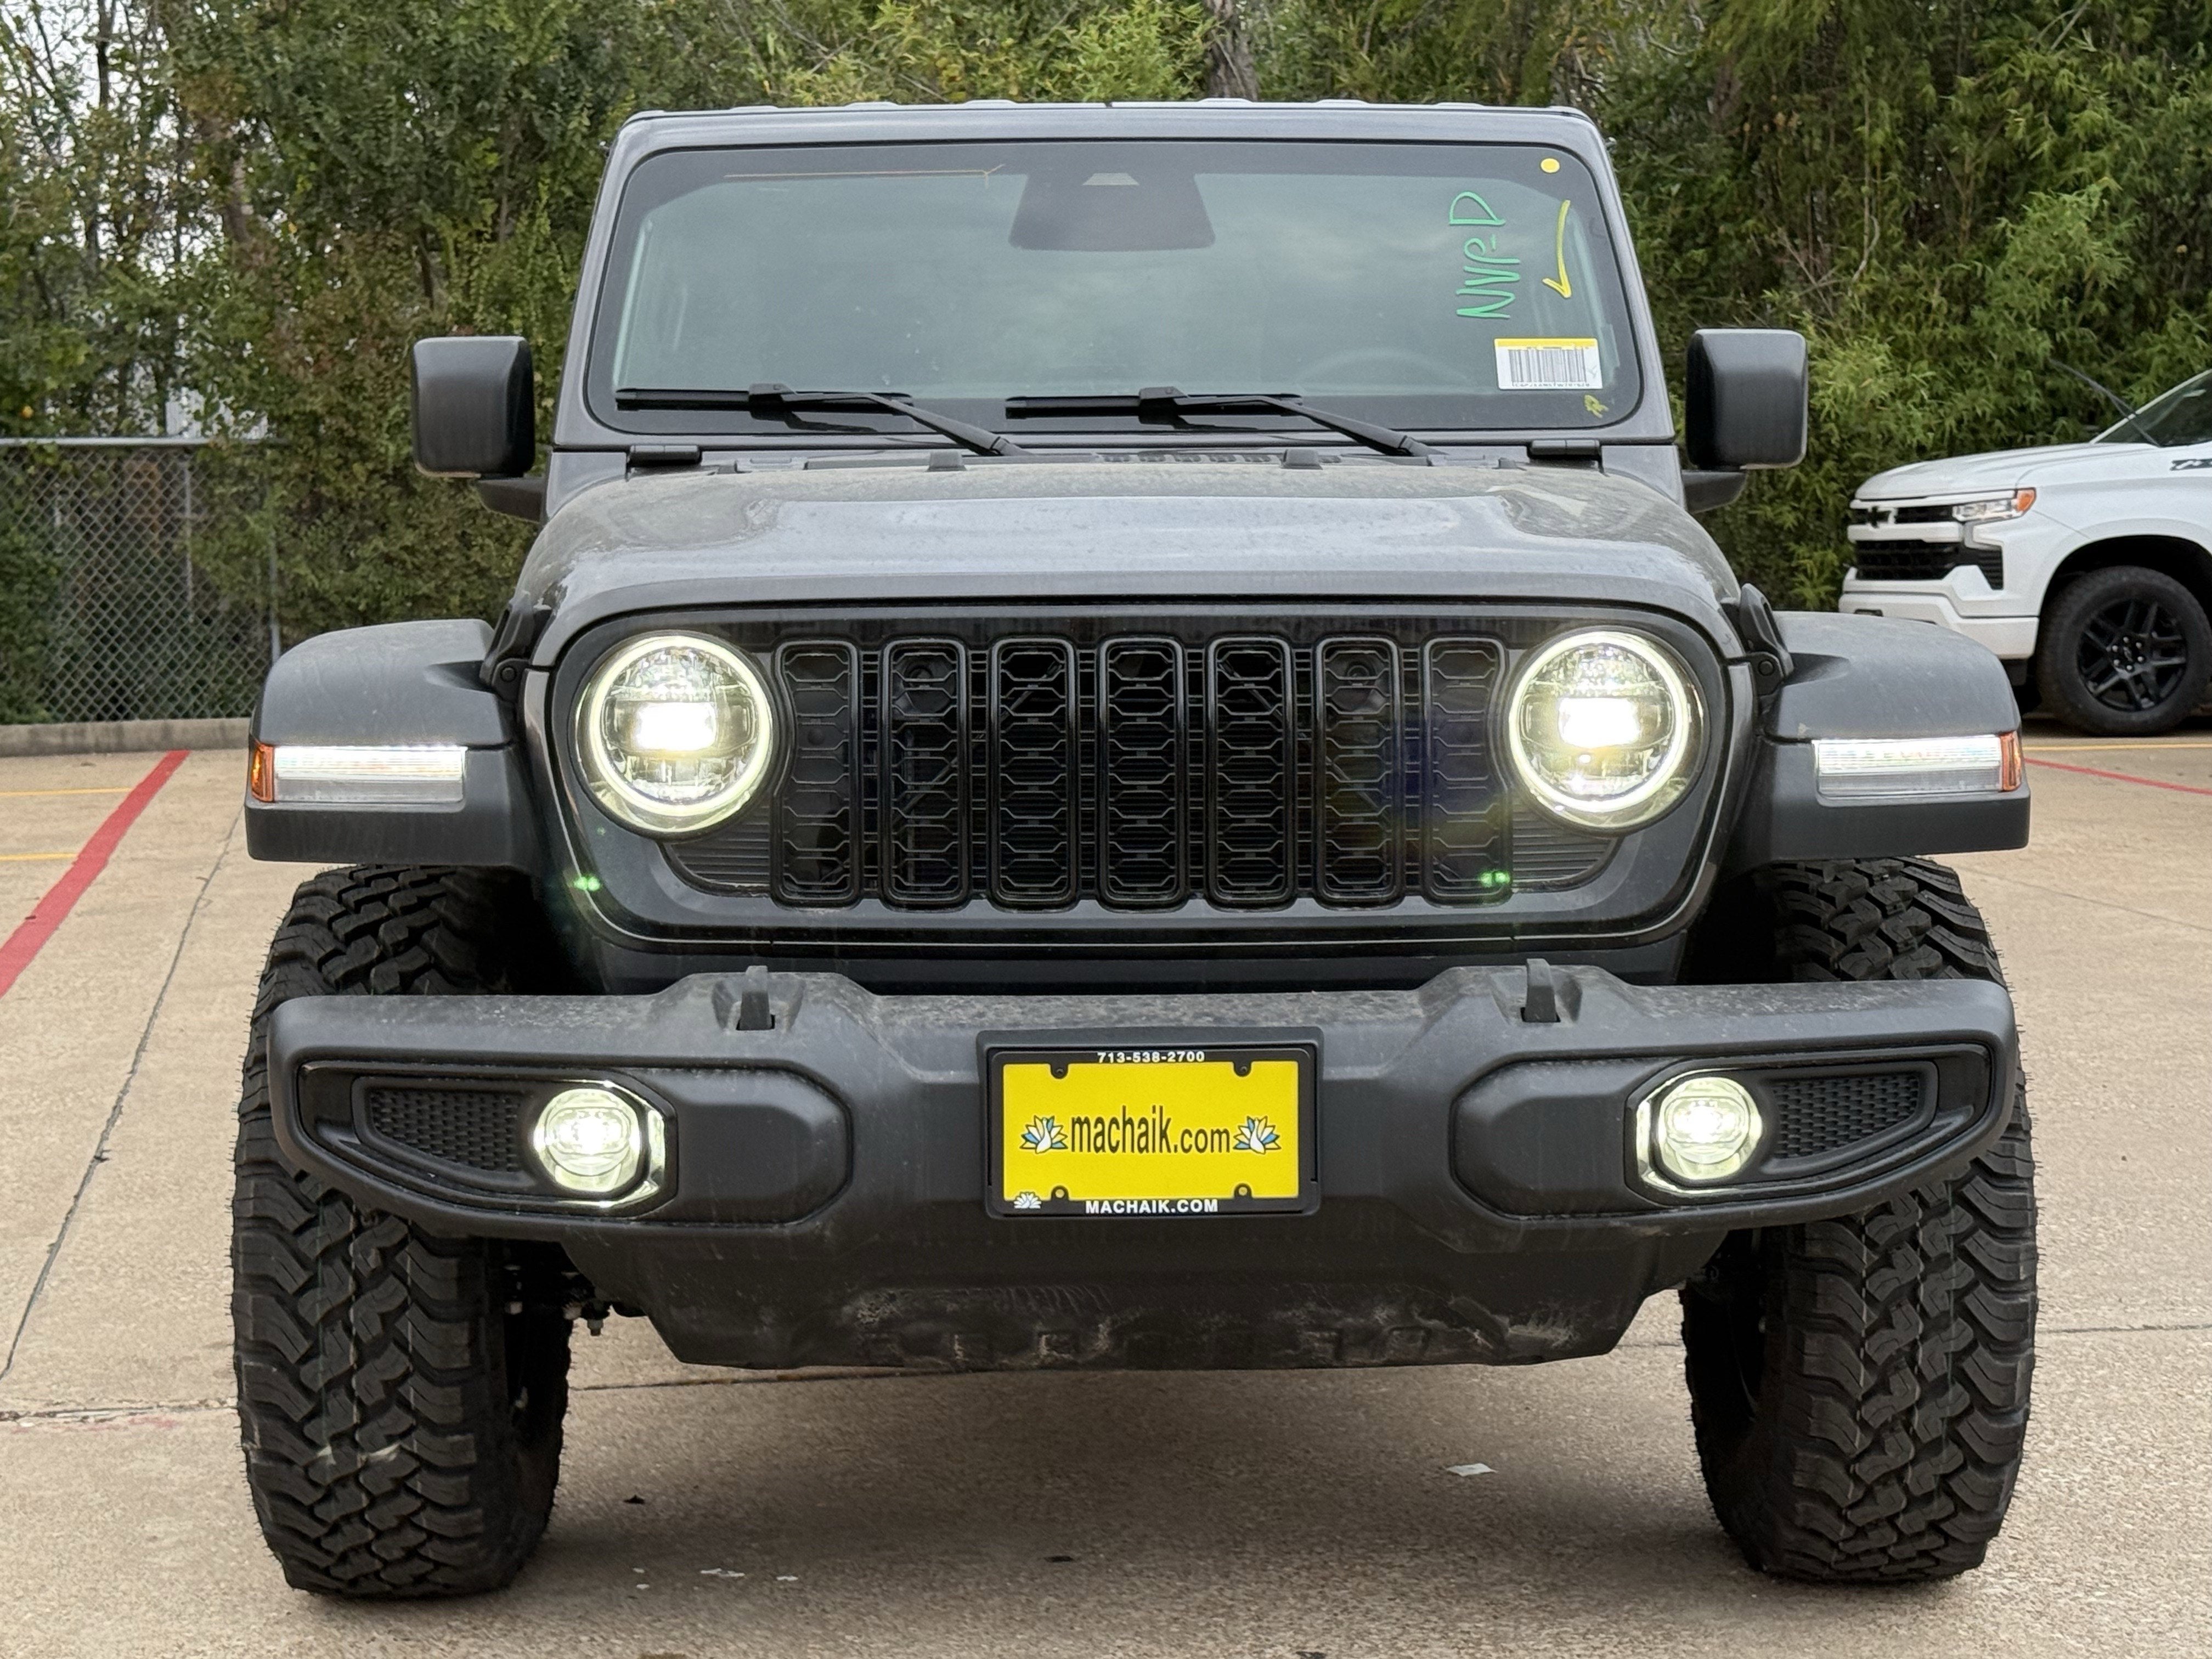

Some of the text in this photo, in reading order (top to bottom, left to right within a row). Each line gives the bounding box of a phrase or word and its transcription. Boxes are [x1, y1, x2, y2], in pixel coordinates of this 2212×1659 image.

[1097, 1051, 1205, 1063] 713-538-2700
[1070, 1104, 1231, 1153] machaik.com
[1085, 1199, 1218, 1214] MACHAIK.COM
